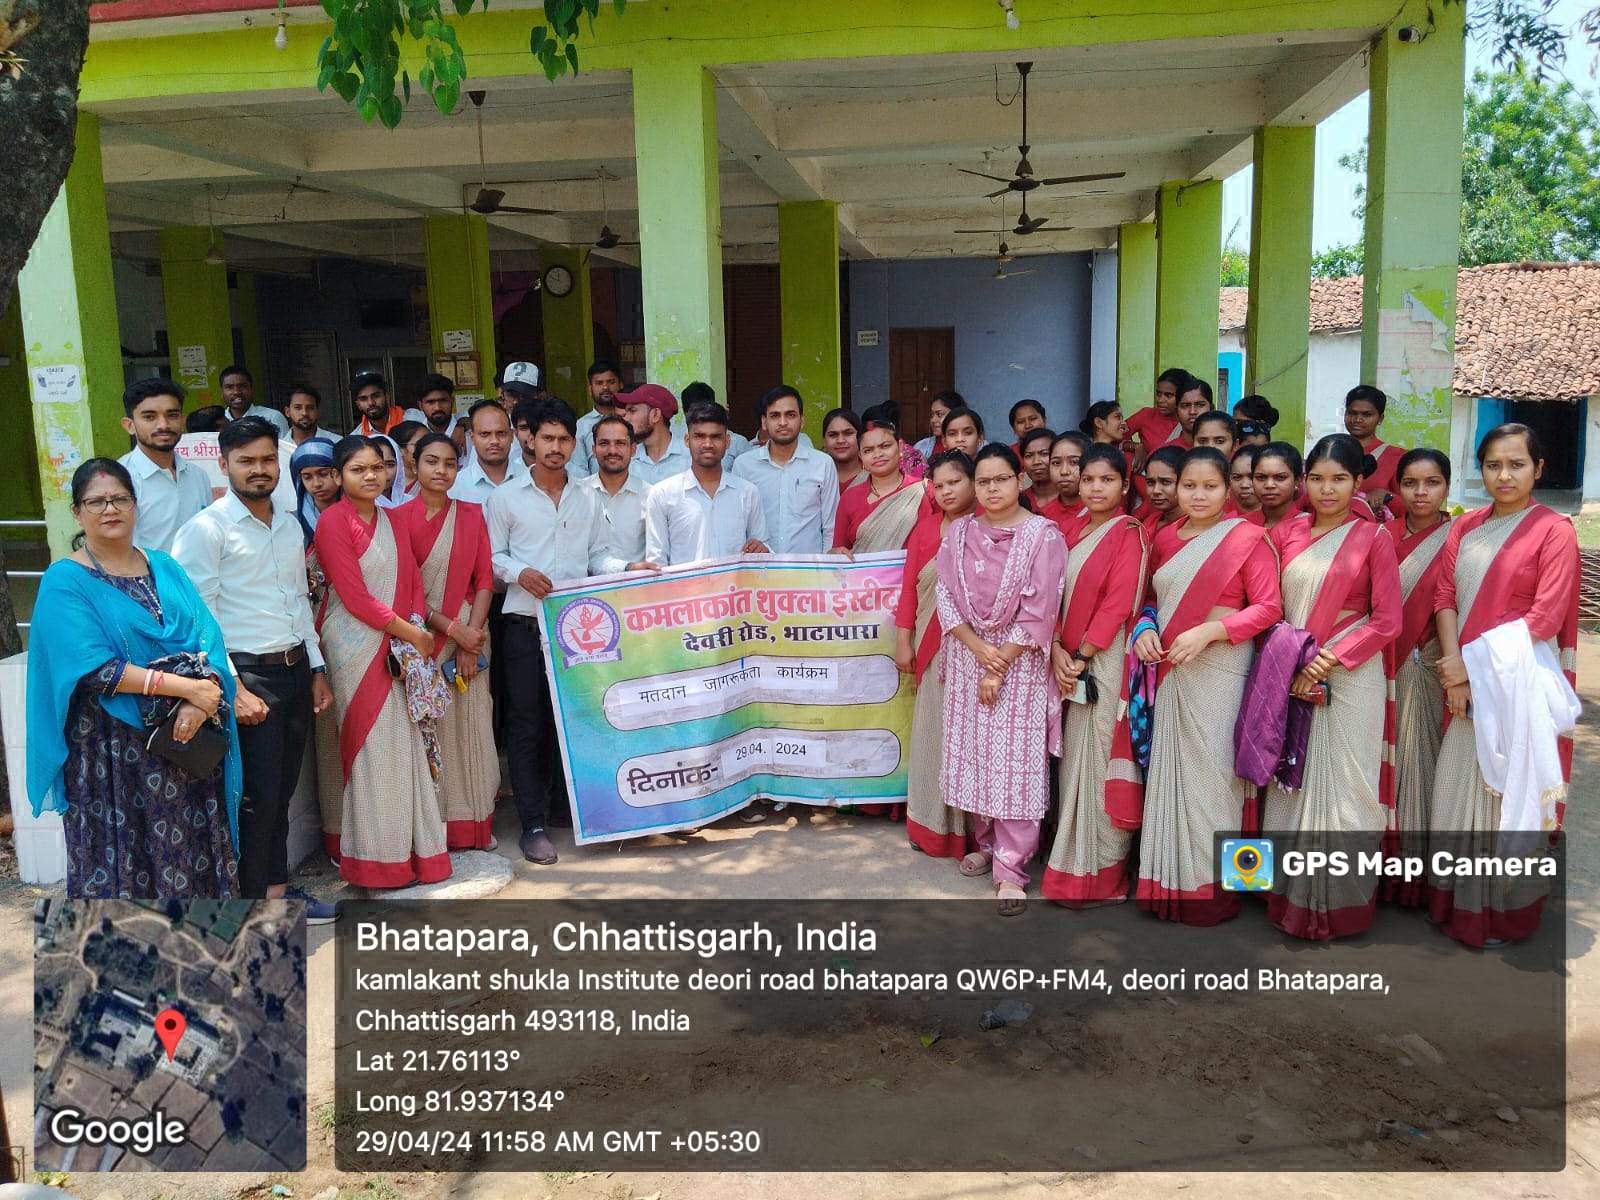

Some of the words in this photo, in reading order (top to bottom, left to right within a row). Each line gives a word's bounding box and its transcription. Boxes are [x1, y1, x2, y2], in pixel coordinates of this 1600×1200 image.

[193, 441, 221, 457] श्रीरा
[623, 586, 753, 632] कमलाकांत
[757, 589, 827, 621] शुक्ला
[682, 626, 735, 651] देवरी
[738, 621, 777, 643] रोड,
[784, 624, 881, 642] भाटापारा
[639, 685, 687, 703] मतदान
[703, 666, 761, 692] जागरूकता
[776, 663, 829, 680] कार्यक्रम
[735, 742, 767, 761] 29.04.
[775, 742, 807, 756] 2024
